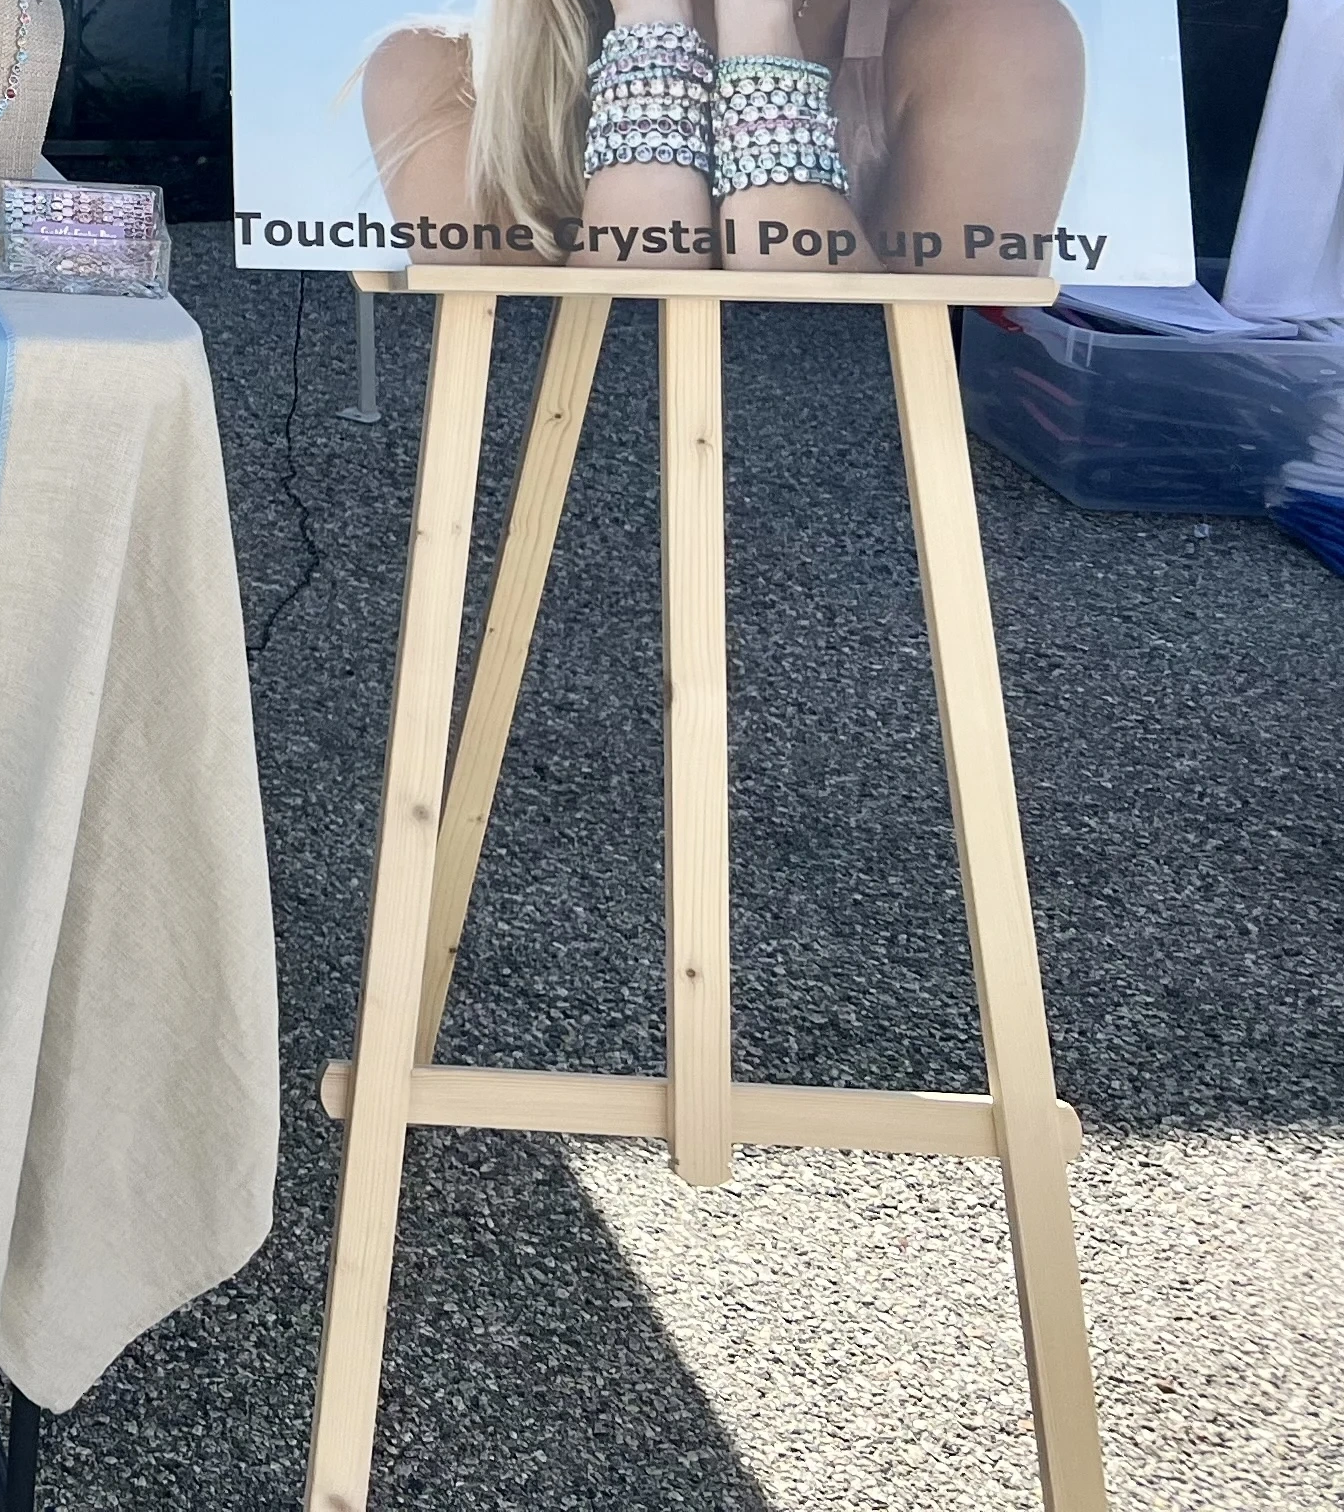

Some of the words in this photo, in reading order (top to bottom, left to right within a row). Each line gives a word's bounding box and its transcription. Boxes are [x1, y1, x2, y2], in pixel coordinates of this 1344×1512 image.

[235, 211, 534, 251] Touchstone
[554, 216, 736, 262] Crystal
[758, 220, 857, 265] Pop
[877, 230, 943, 267] up
[963, 224, 1108, 271] Party
